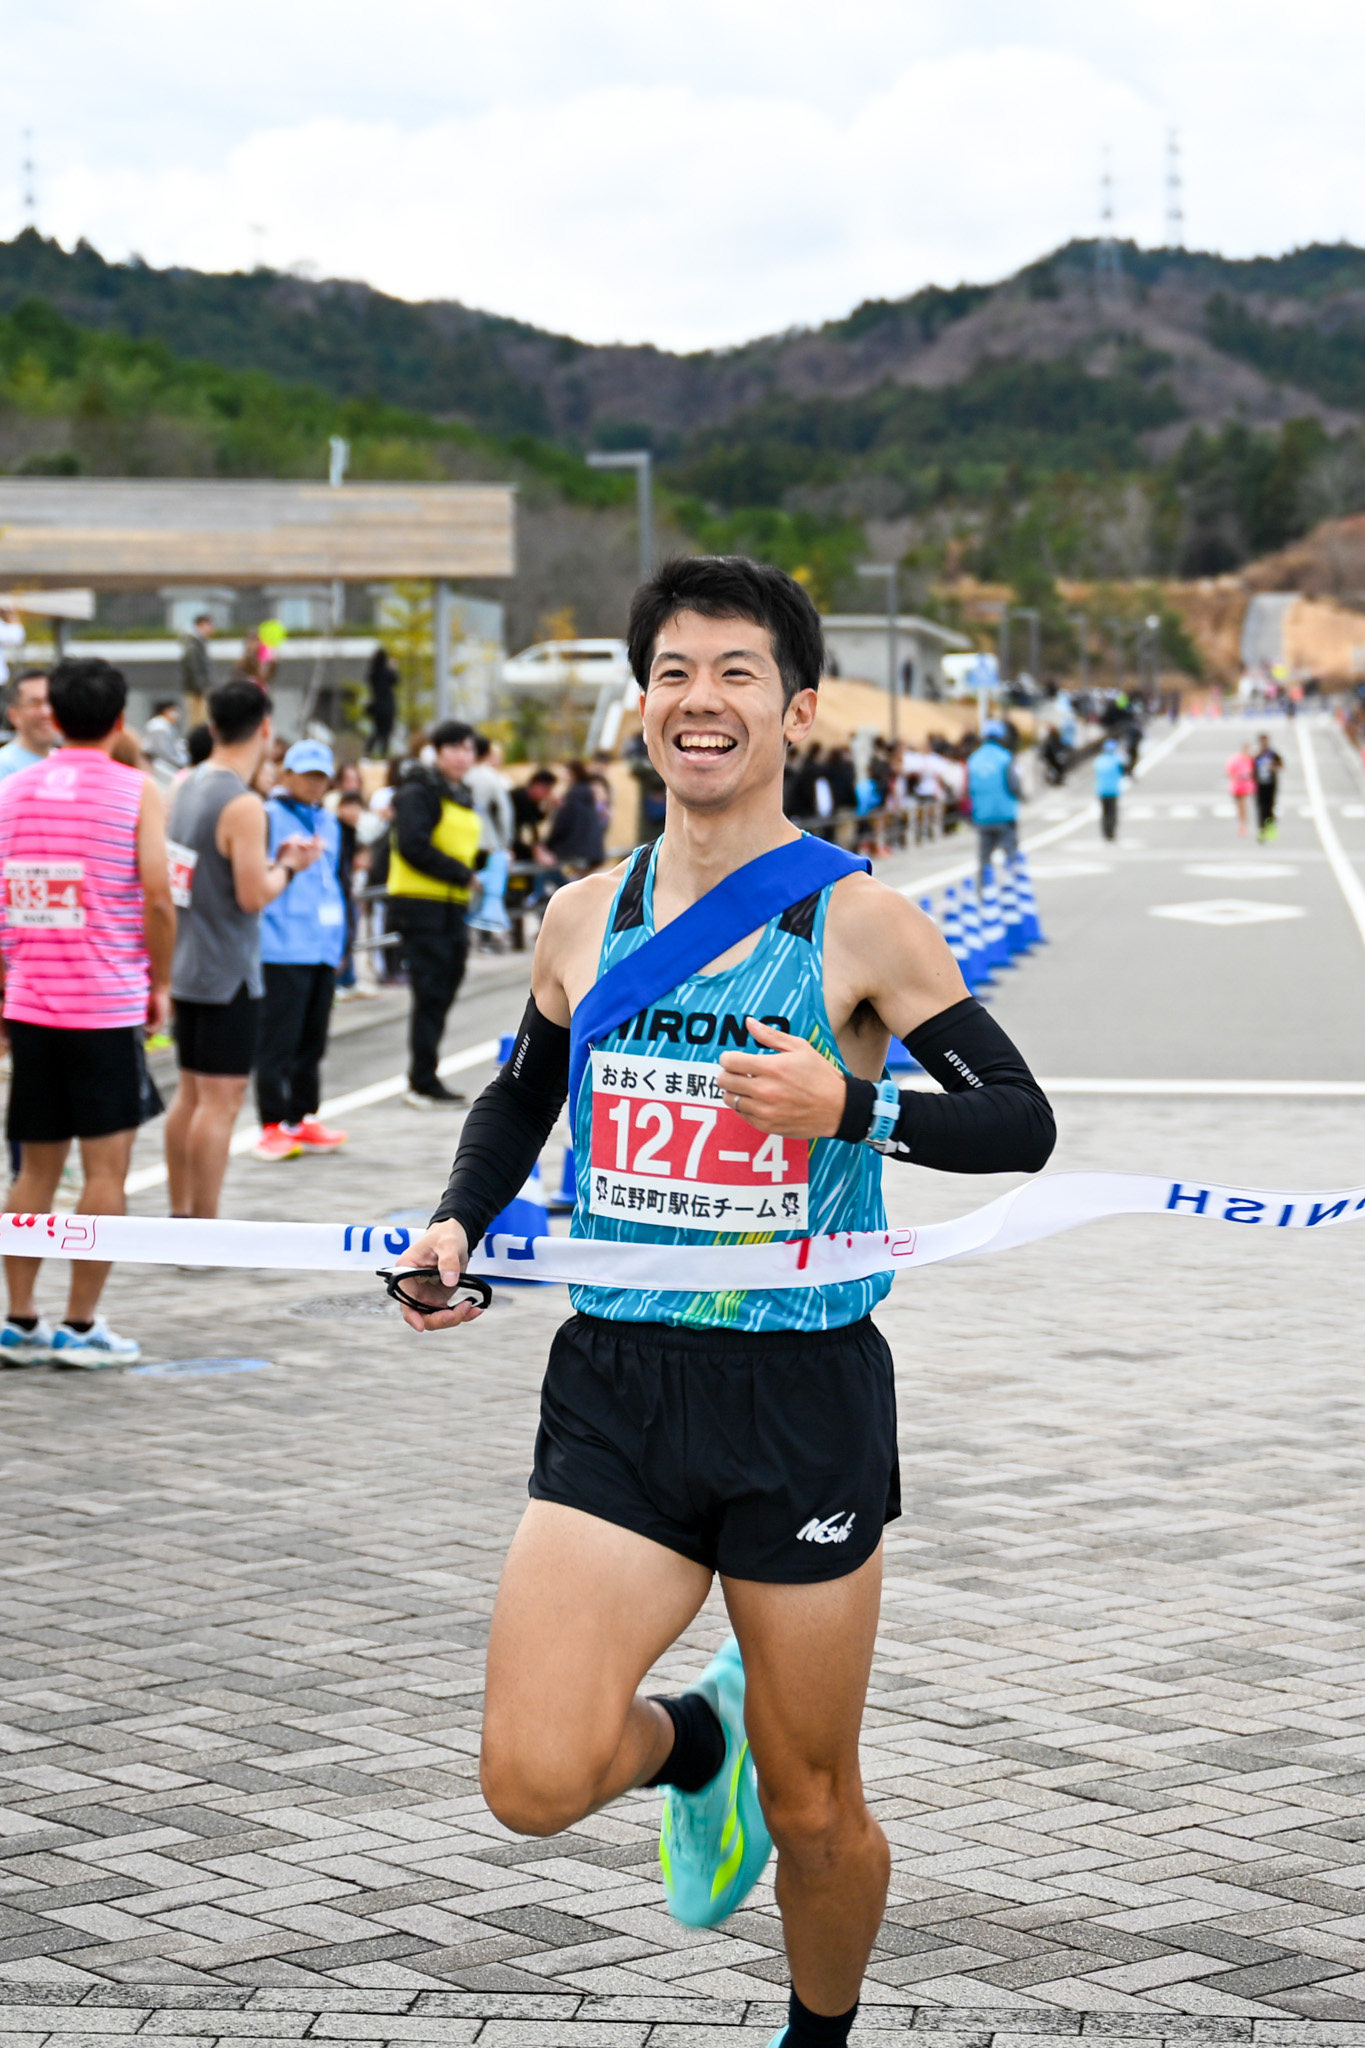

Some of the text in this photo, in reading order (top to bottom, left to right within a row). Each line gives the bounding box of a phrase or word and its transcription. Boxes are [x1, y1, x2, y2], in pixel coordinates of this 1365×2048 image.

[608, 1098, 789, 1183] 127-4
[611, 1184, 776, 1218] 広野町駅伝チーム
